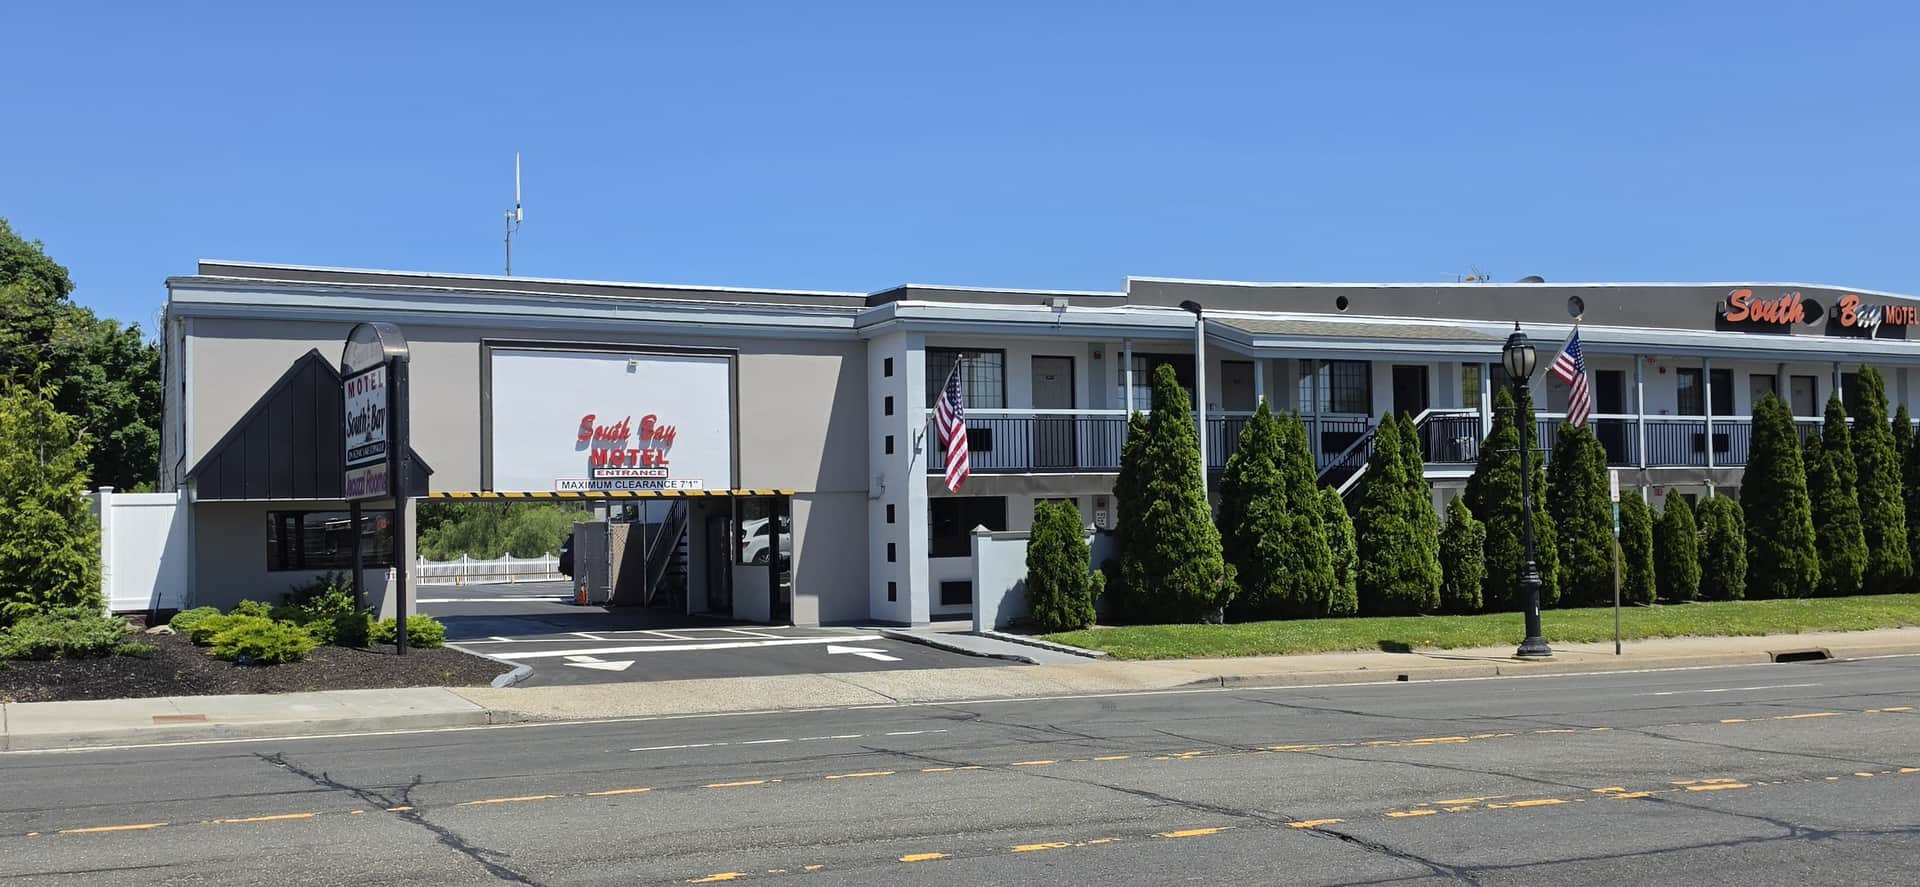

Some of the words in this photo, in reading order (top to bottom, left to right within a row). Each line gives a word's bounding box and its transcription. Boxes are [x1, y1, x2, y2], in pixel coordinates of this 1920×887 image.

[1727, 289, 1805, 325] South
[1839, 294, 1882, 339] Bay
[1886, 305, 1919, 326] MOTEL
[348, 370, 384, 400] MOTEL
[347, 406, 367, 438] South
[371, 404, 386, 436] Bay
[578, 414, 631, 443] South
[640, 414, 677, 447] Bay
[591, 448, 669, 466] MOTEL
[561, 480, 612, 490] MAXIMUM
[615, 480, 677, 490] CLEARANCE
[596, 469, 666, 477] ENTRANCE
